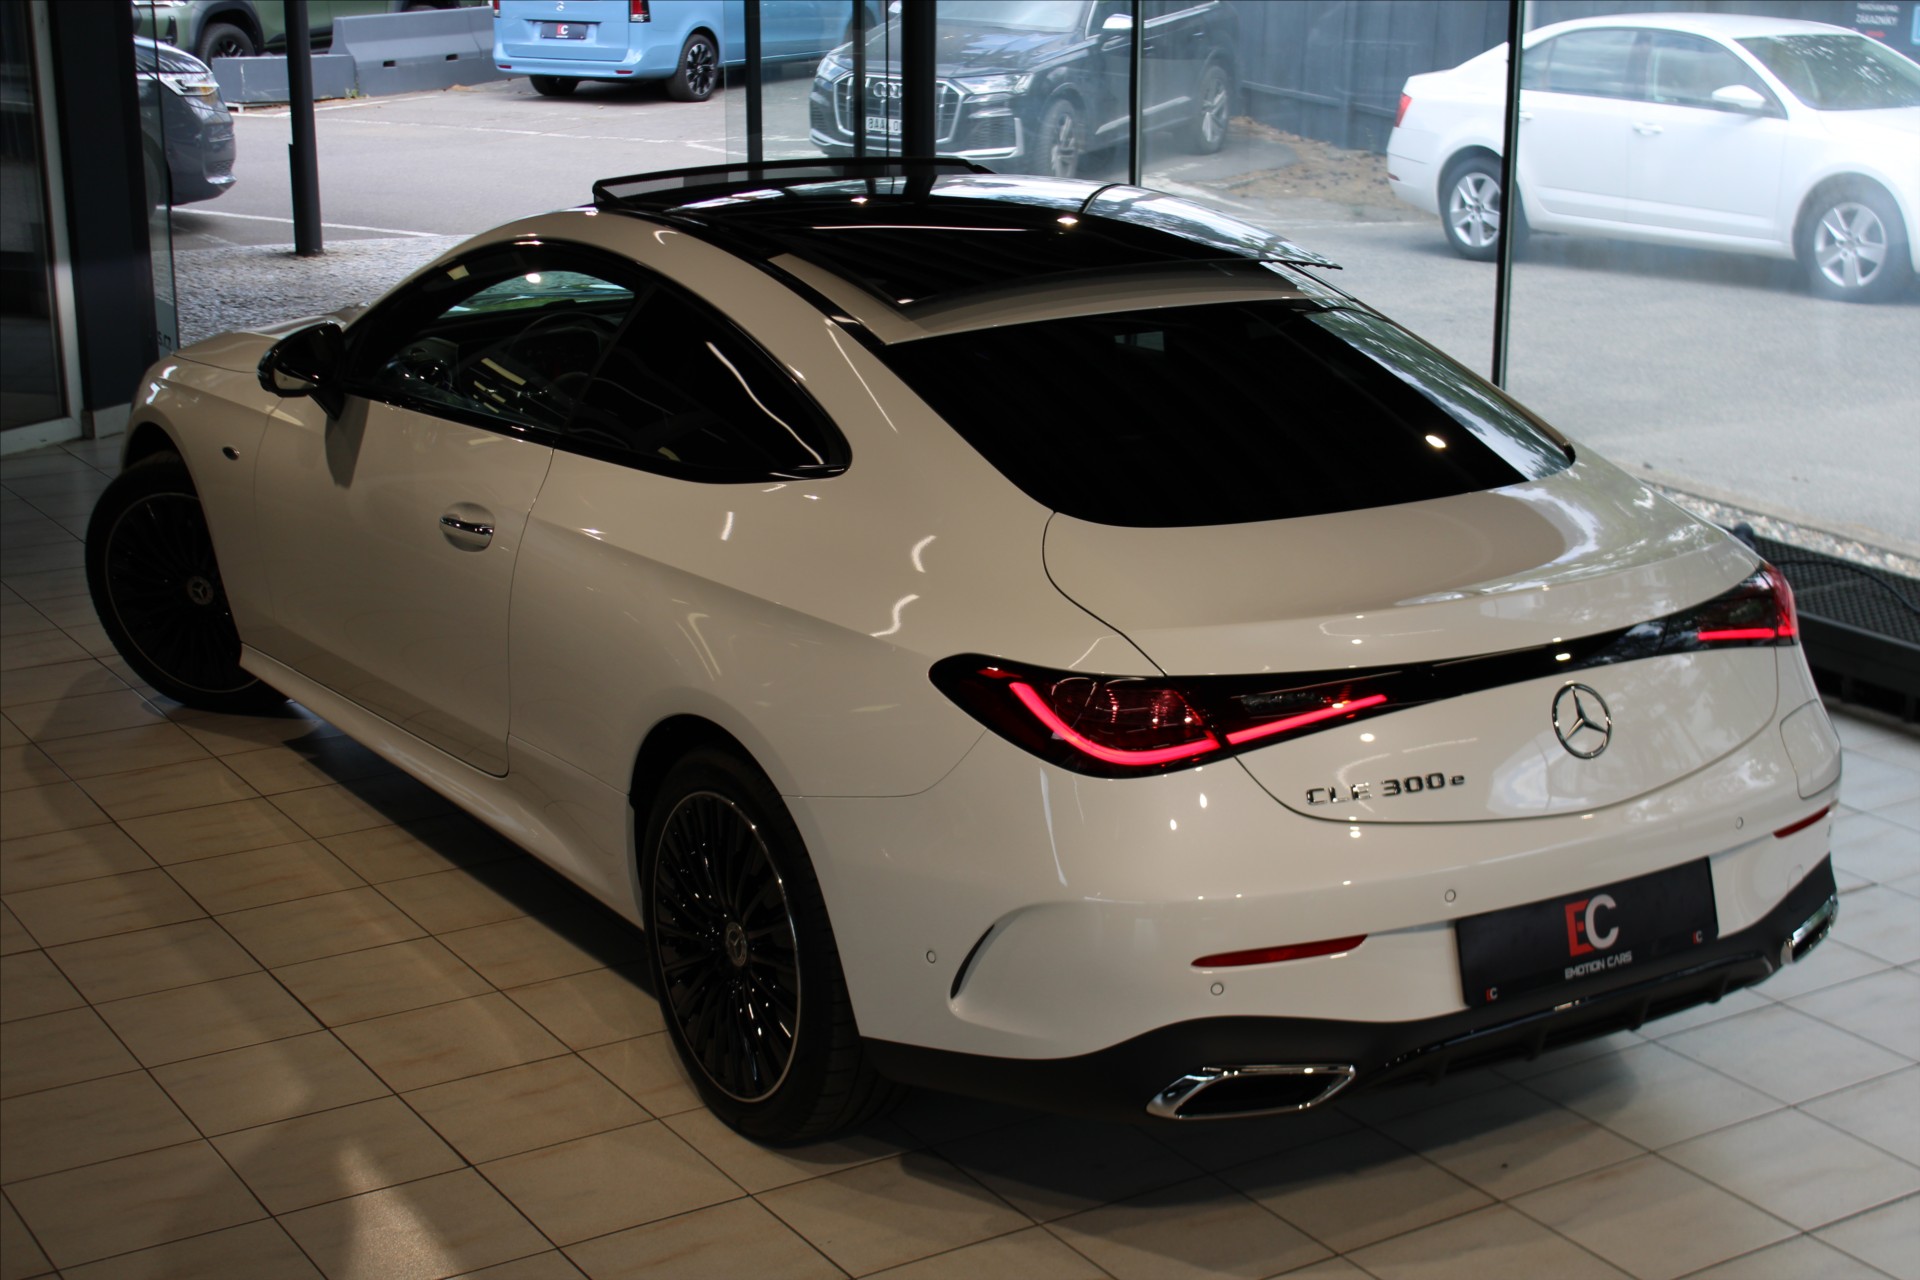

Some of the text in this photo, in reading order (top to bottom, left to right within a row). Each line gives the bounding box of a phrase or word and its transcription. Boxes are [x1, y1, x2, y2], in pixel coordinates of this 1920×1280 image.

[1306, 782, 1372, 805] CLE
[1565, 894, 1619, 957] EC
[1565, 950, 1632, 980] EMOTION CARS
